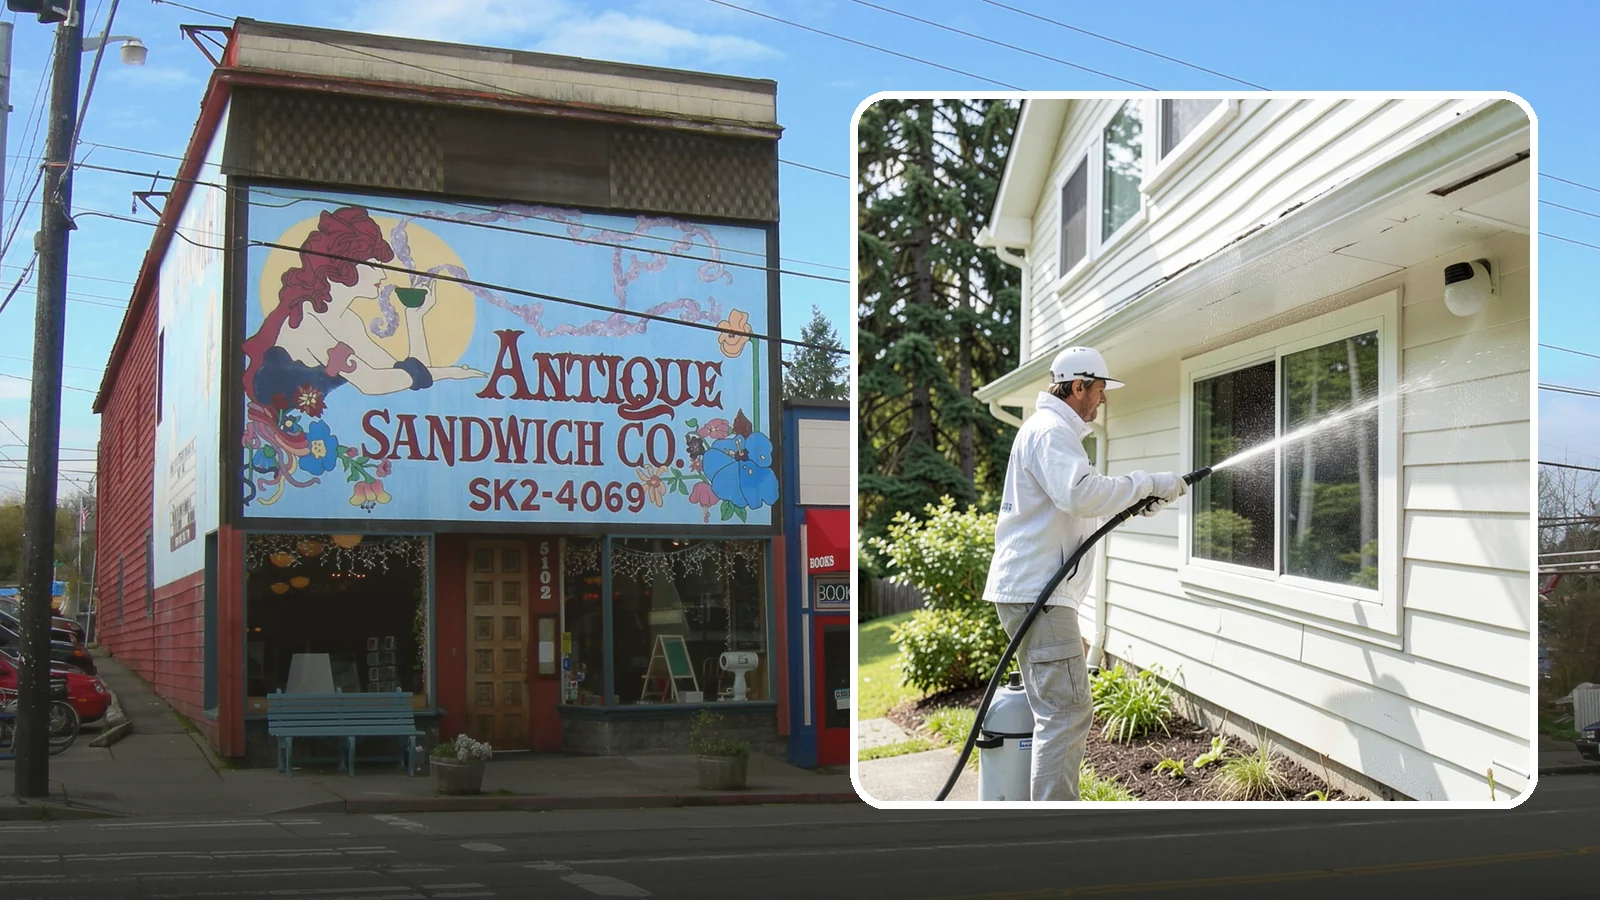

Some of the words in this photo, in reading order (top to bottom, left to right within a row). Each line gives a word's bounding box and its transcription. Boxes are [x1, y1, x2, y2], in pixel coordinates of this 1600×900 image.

[475, 329, 723, 421] ANTIQUE
[361, 408, 604, 467] SANDWICH
[617, 422, 685, 468] CO.
[468, 477, 646, 513] SK2-4069
[540, 541, 551, 599] 5102
[810, 555, 834, 569] BOOKS
